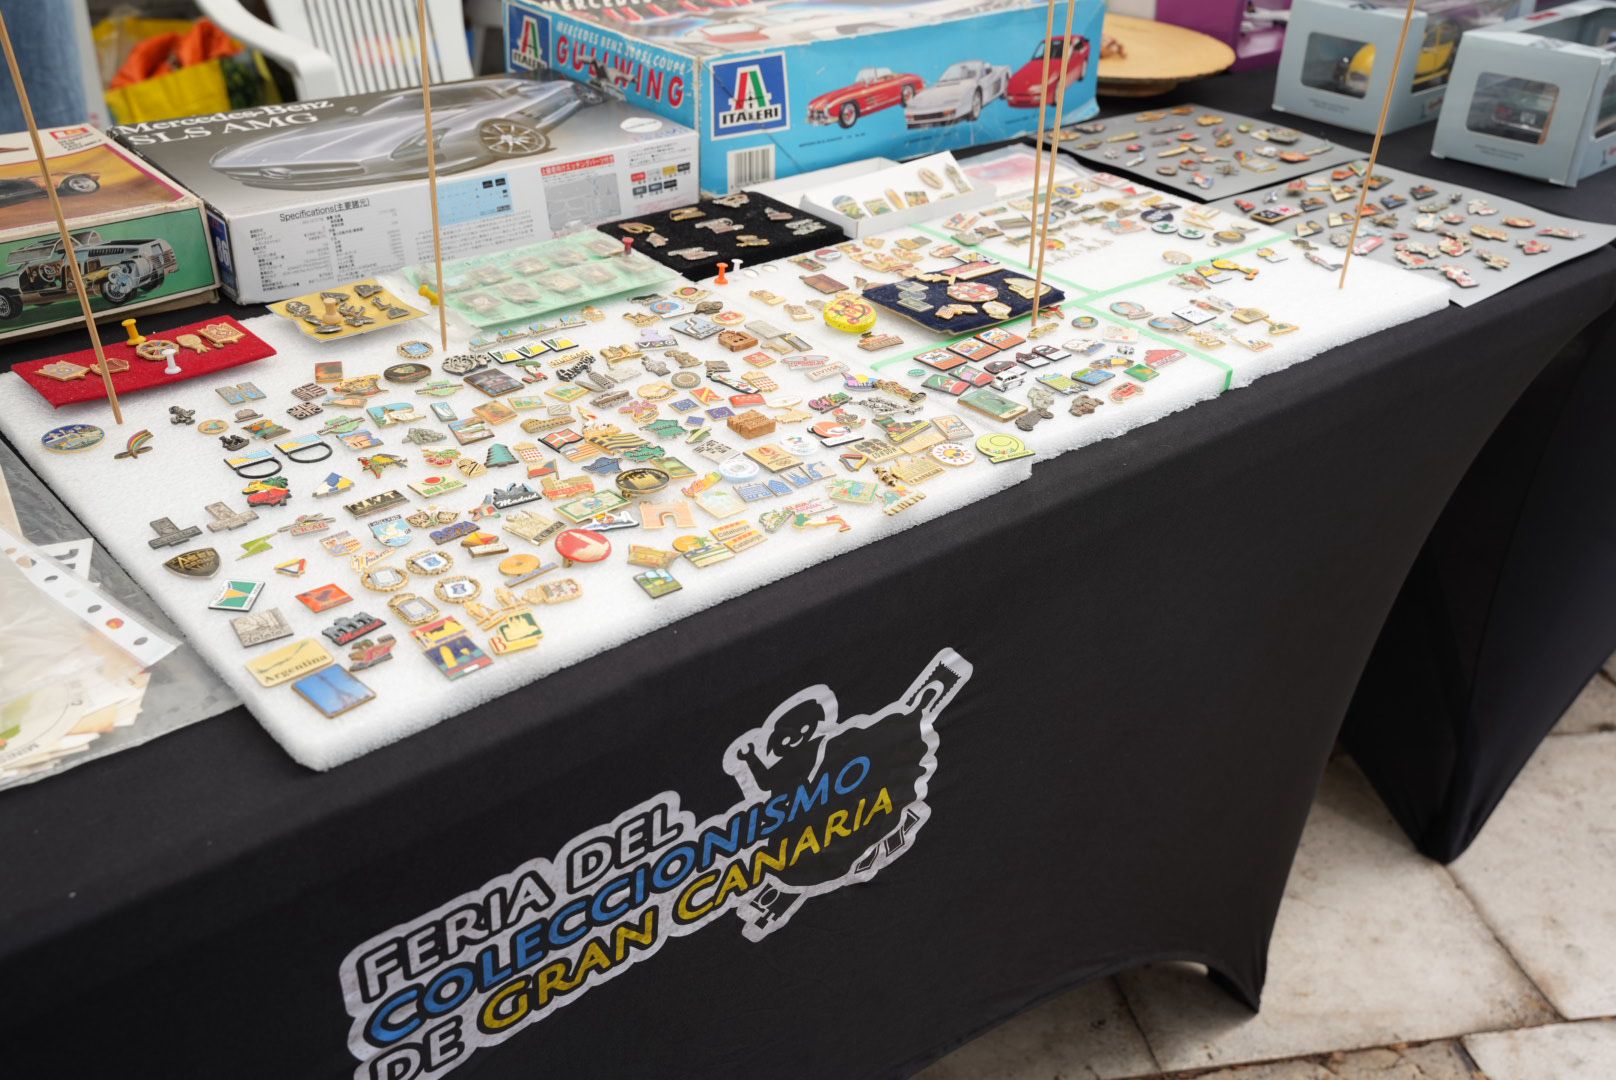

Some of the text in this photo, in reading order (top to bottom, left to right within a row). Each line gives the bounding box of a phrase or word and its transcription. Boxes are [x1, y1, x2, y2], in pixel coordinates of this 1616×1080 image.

[556, 21, 599, 45] MERCEDES
[601, 36, 623, 55] BENZ
[119, 100, 334, 135] Mercedes-Benz
[128, 112, 318, 146] SLS AMG
[722, 108, 778, 125] ITALERI
[496, 493, 539, 508] Madrid
[264, 655, 328, 683] Argentina
[363, 806, 682, 998] FERIA DEL
[370, 755, 871, 1043] COLECCIONISMO
[384, 786, 893, 1080] DE GRAN CANARIA
